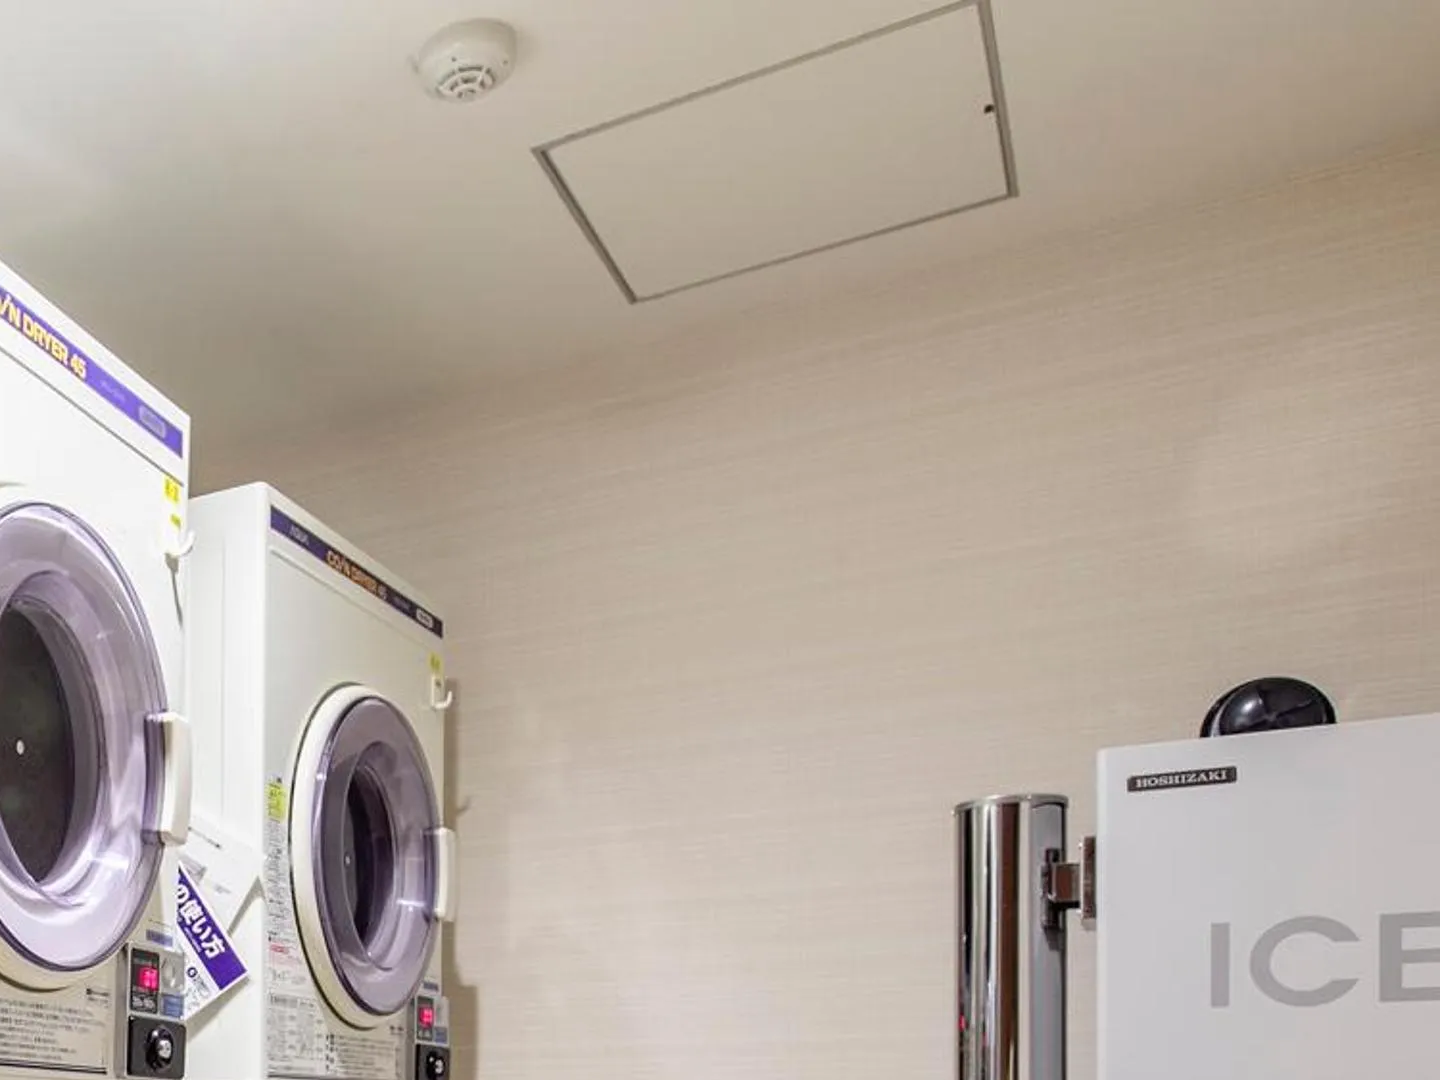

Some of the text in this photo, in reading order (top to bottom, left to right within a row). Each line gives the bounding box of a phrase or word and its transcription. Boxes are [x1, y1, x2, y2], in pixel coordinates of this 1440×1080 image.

[22, 313, 68, 366] DRYER
[1135, 769, 1229, 790] HOSHIZAKI
[1209, 912, 1440, 1009] ICE
